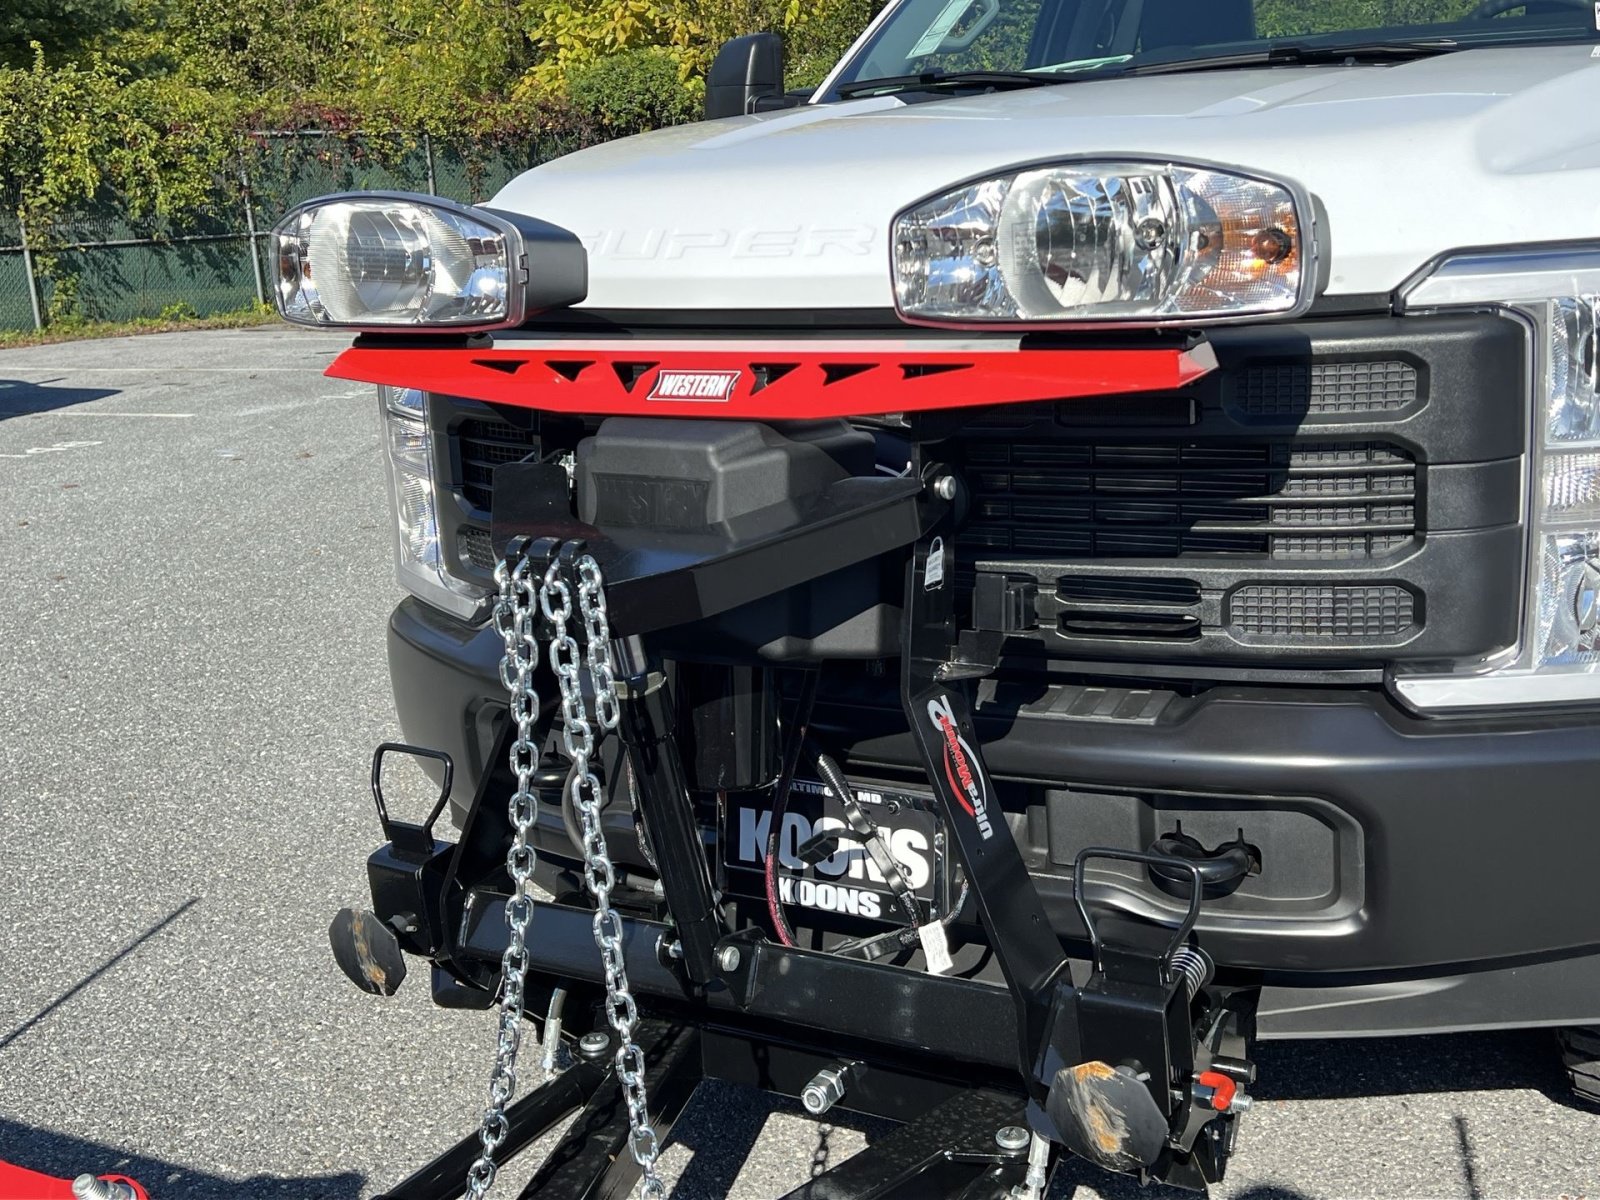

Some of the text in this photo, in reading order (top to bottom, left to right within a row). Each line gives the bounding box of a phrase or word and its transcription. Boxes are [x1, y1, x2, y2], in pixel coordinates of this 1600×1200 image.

[658, 374, 731, 397] WESTERN
[857, 791, 882, 804] MD
[739, 807, 930, 890] KOONS
[778, 877, 881, 919] KOONS
